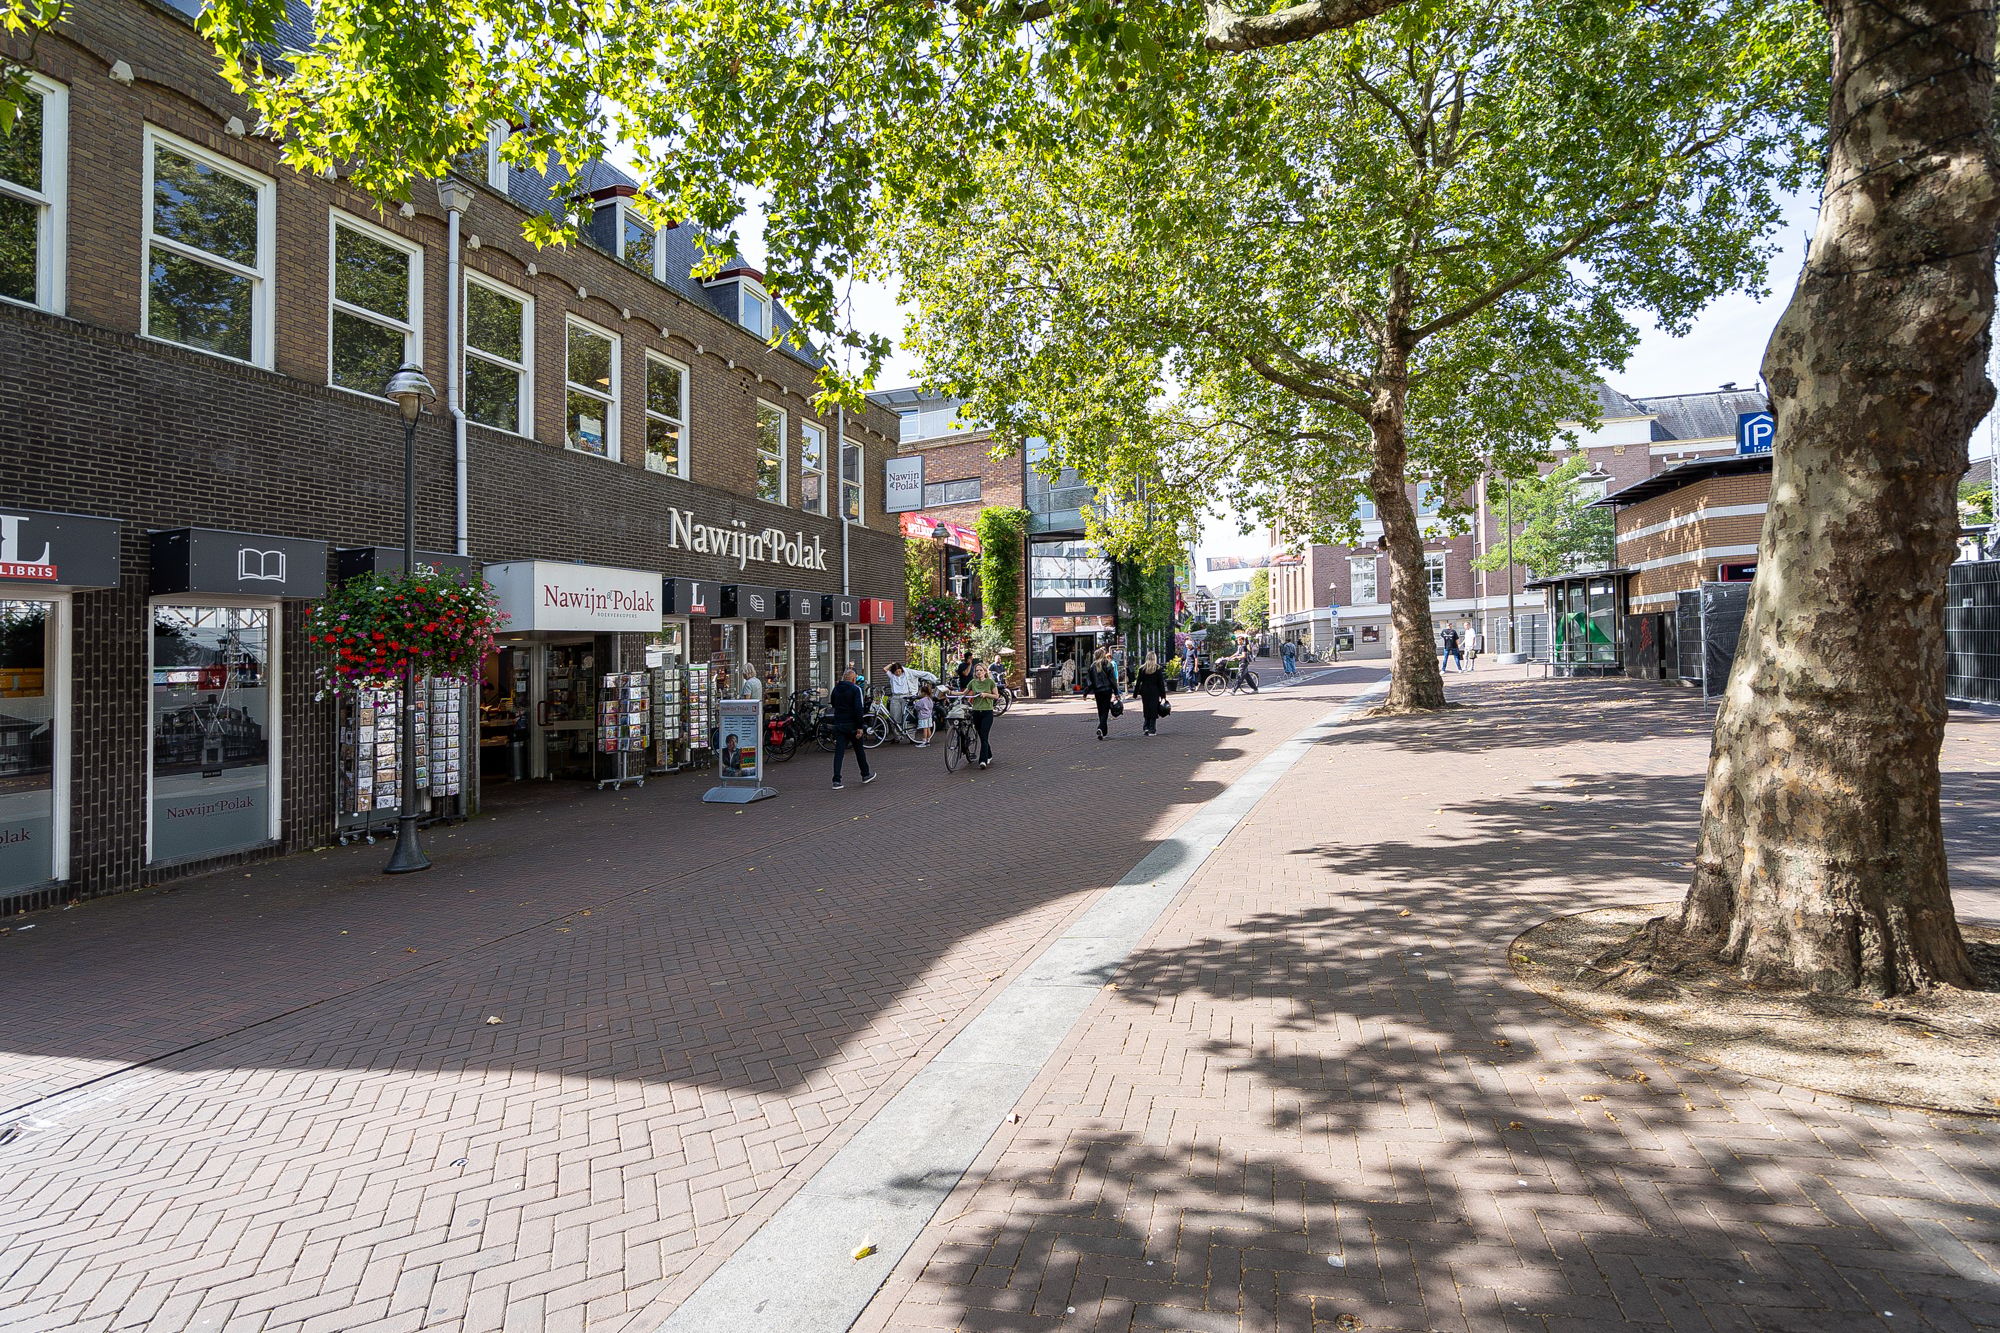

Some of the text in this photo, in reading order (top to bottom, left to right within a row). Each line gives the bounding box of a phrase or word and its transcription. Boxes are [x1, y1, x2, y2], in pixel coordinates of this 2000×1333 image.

[1754, 424, 1772, 446] P
[889, 470, 919, 482] Nawijn
[895, 480, 919, 491] Polak
[667, 507, 764, 571] Nawijn
[771, 529, 827, 571] Polak
[0, 565, 53, 577] LIBRIS
[544, 585, 607, 615] Nawijn
[613, 590, 655, 612] Polak
[691, 582, 705, 606] L
[167, 803, 215, 819] Nawijn
[220, 796, 254, 811] Polak
